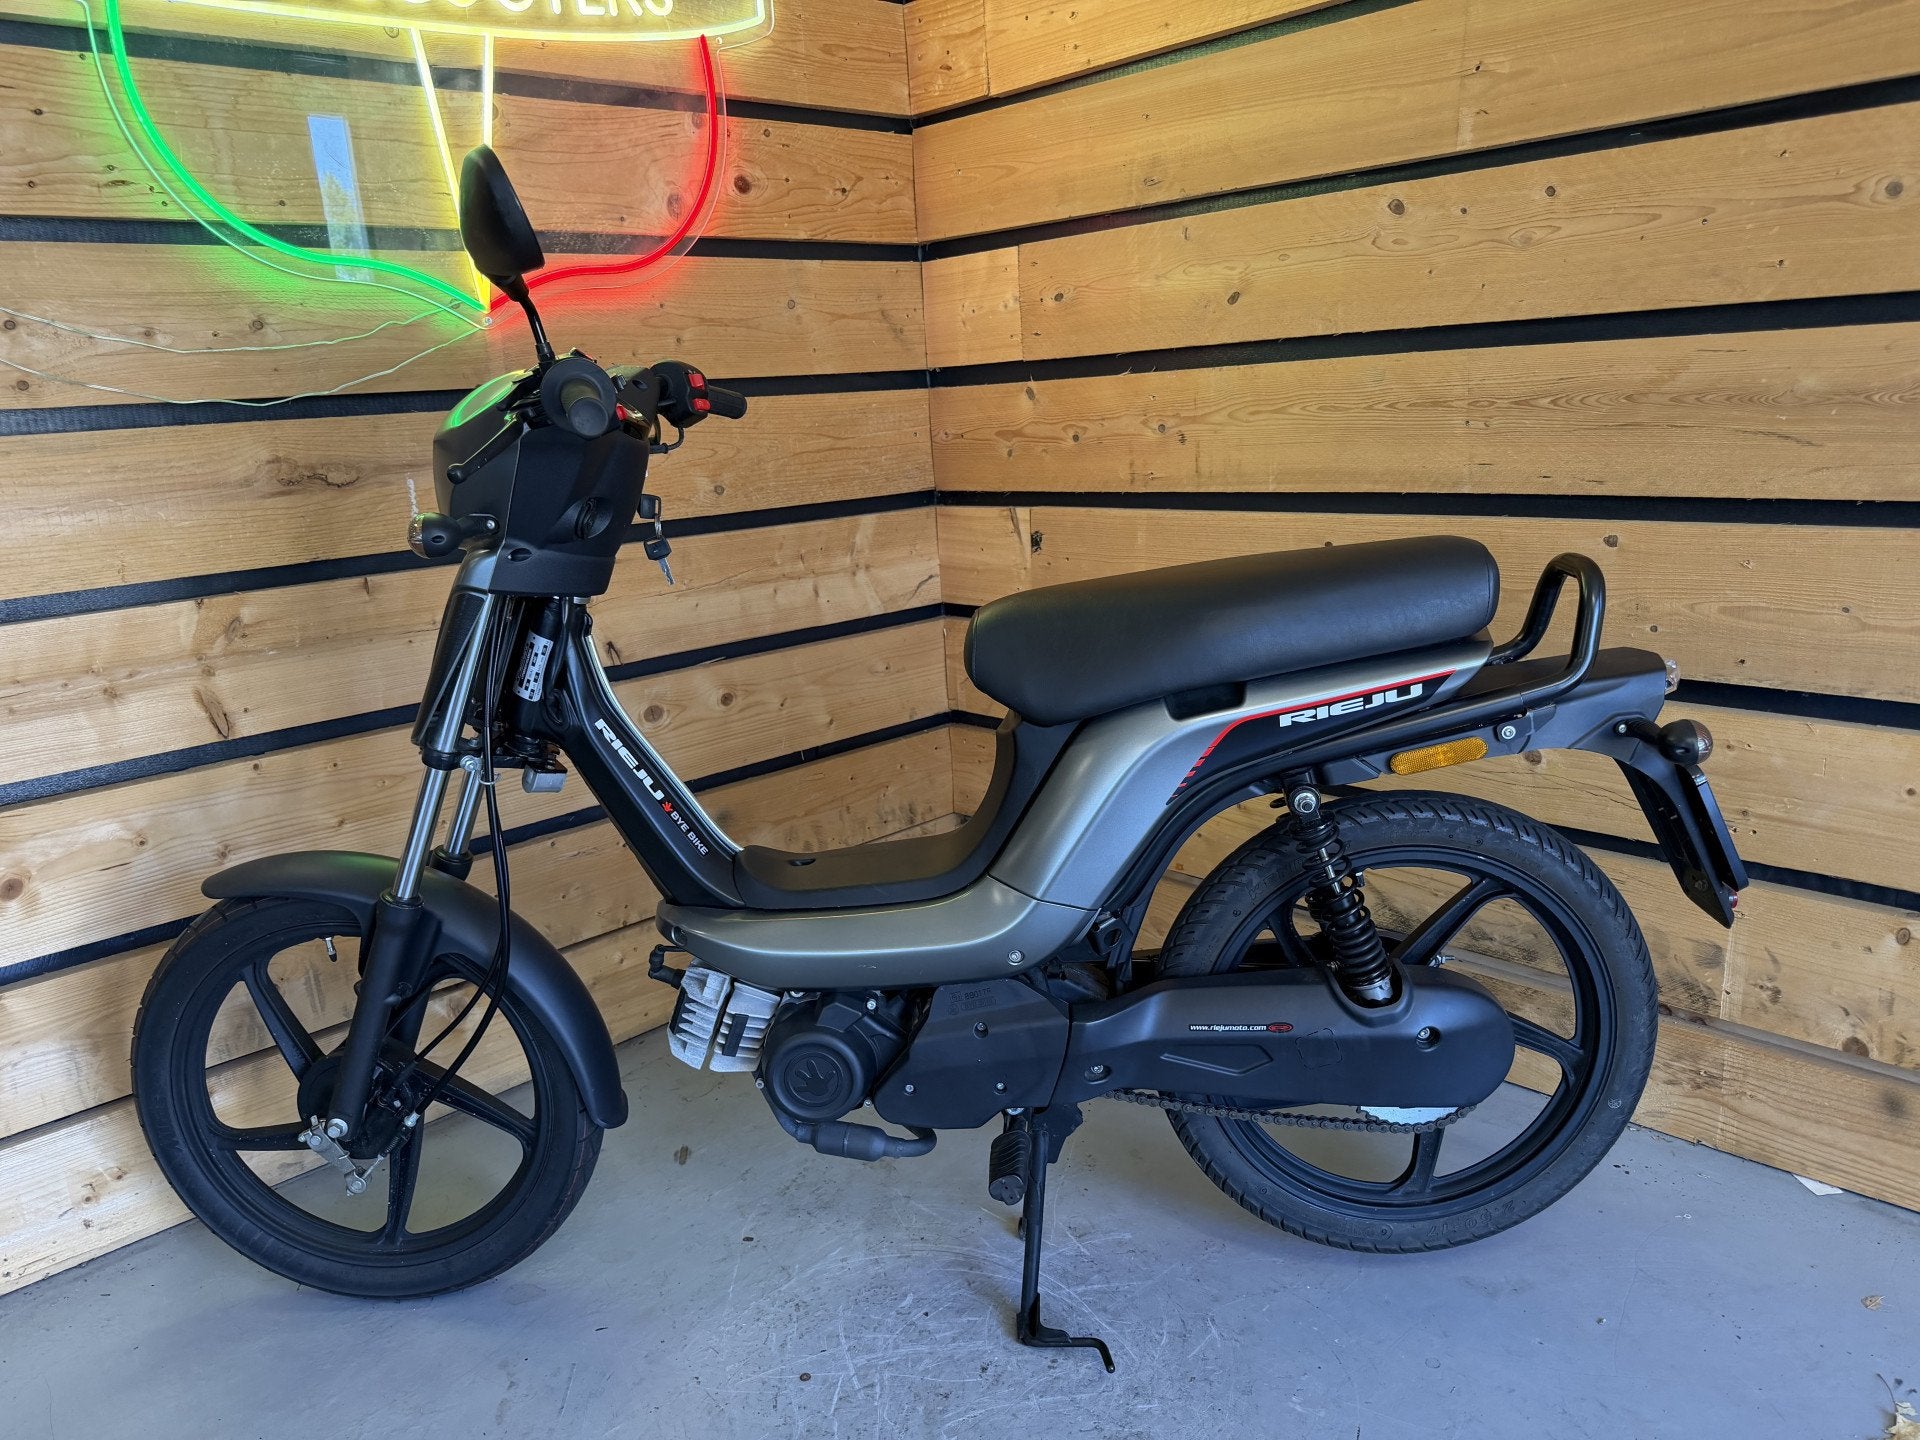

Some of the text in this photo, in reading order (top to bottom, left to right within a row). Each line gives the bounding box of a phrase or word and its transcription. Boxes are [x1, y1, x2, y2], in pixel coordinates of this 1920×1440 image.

[1280, 683, 1422, 727] RIEJU
[594, 718, 709, 855] RIEJU BYE BIKE
[1190, 1024, 1267, 1032] www.riejumoto.com
